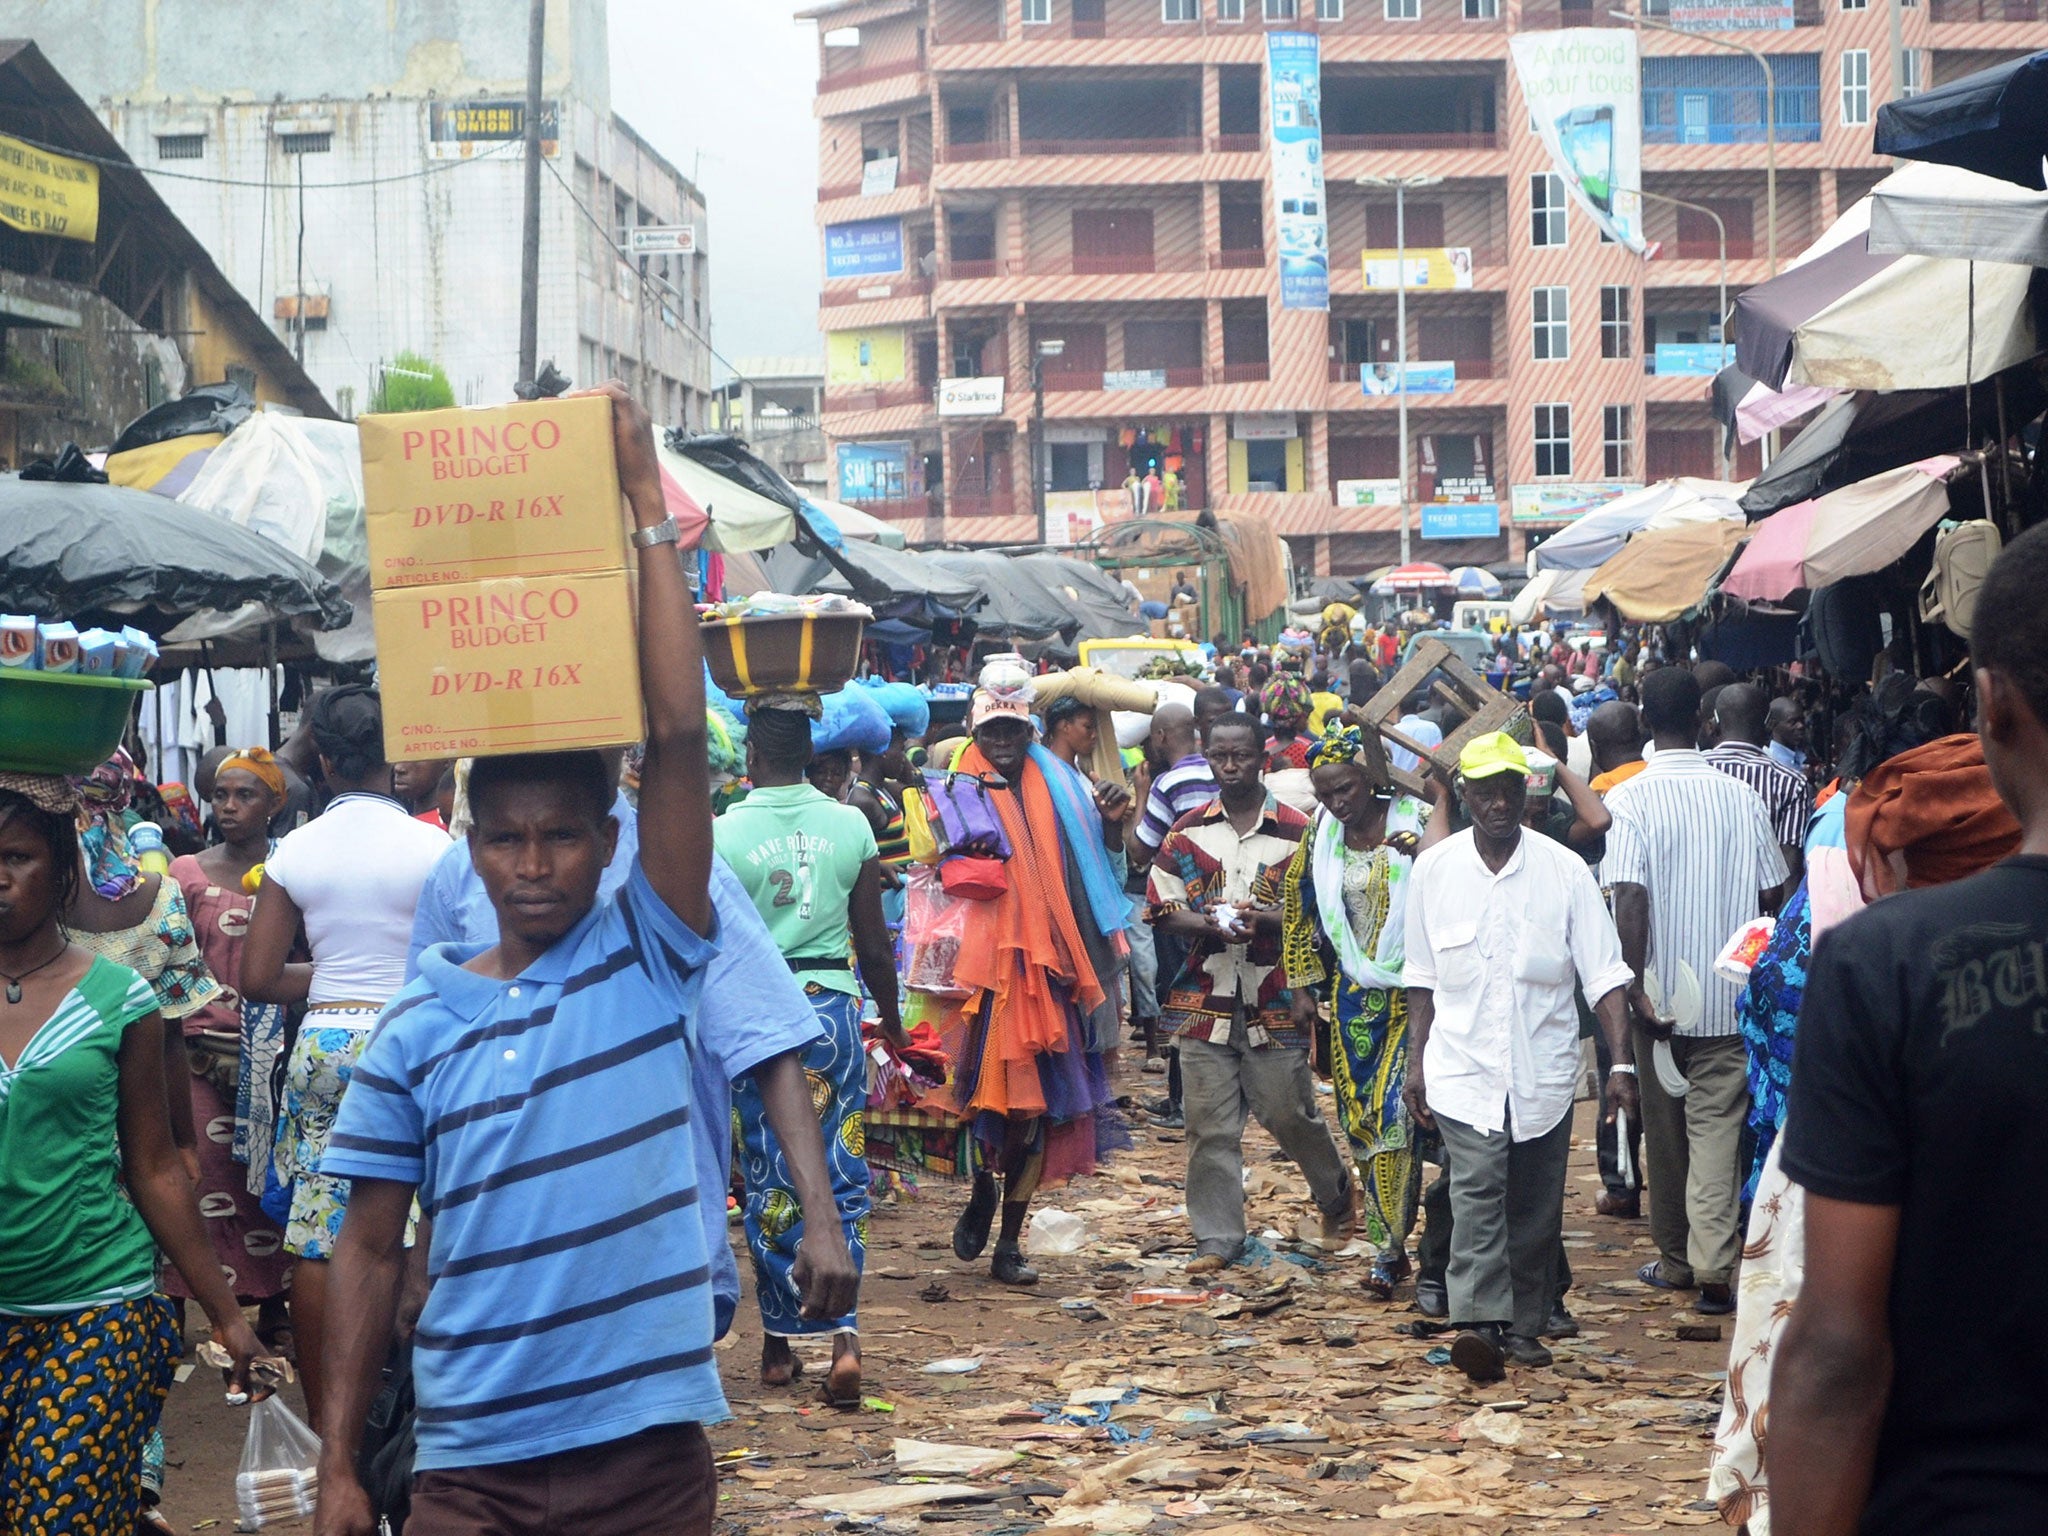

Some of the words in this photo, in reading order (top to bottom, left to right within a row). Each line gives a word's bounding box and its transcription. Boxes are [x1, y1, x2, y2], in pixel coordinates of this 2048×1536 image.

[1533, 41, 1625, 66] Android
[1526, 74, 1578, 98] pour
[1588, 70, 1635, 94] tous
[456, 121, 511, 133] UNION
[403, 420, 560, 460] PRINCO
[432, 453, 530, 480] BUDGET
[412, 499, 506, 528] DVD-R
[514, 495, 565, 519] 16X
[386, 572, 440, 585] ARTICLE
[421, 588, 579, 629] PRINCO
[450, 622, 548, 649] BUDGET
[430, 668, 523, 696] DVD-R
[533, 663, 582, 688] 16X
[985, 701, 1016, 712] DEKRA
[404, 740, 457, 753] ARTICLE
[746, 838, 784, 867] WAVE
[786, 834, 835, 856] RIDERS
